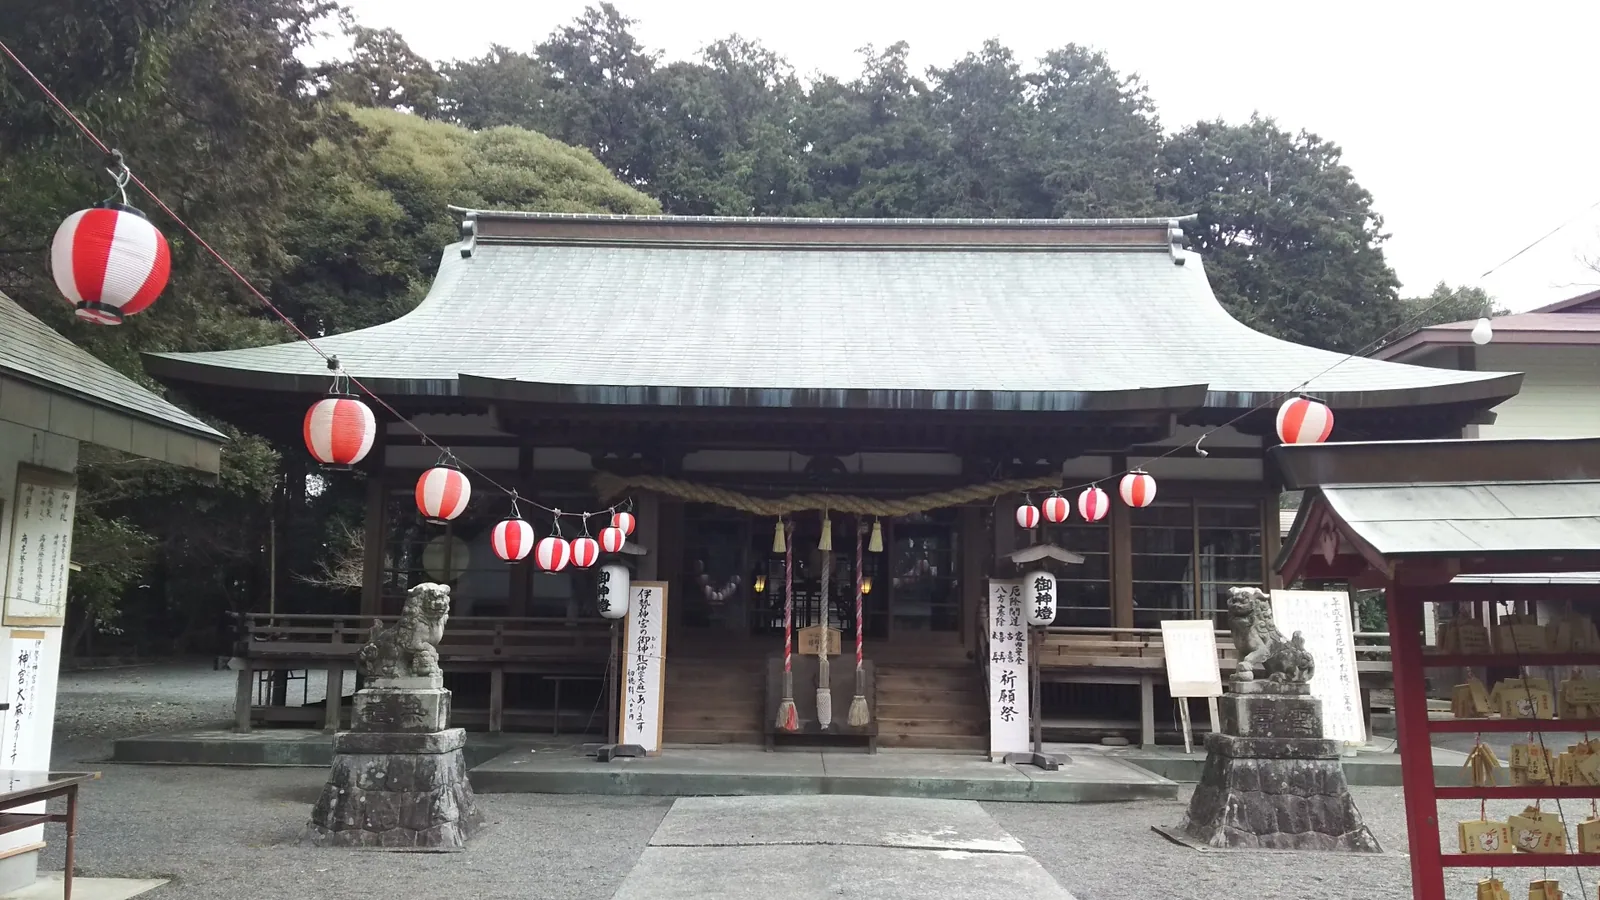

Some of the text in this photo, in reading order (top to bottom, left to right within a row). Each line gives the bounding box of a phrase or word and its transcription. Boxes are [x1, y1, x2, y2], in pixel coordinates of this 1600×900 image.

[1009, 585, 1021, 627] 厄除開運
[1034, 576, 1053, 620] 御神燈
[1015, 631, 1025, 665] 家内安全
[998, 669, 1019, 722] 祈願祭
